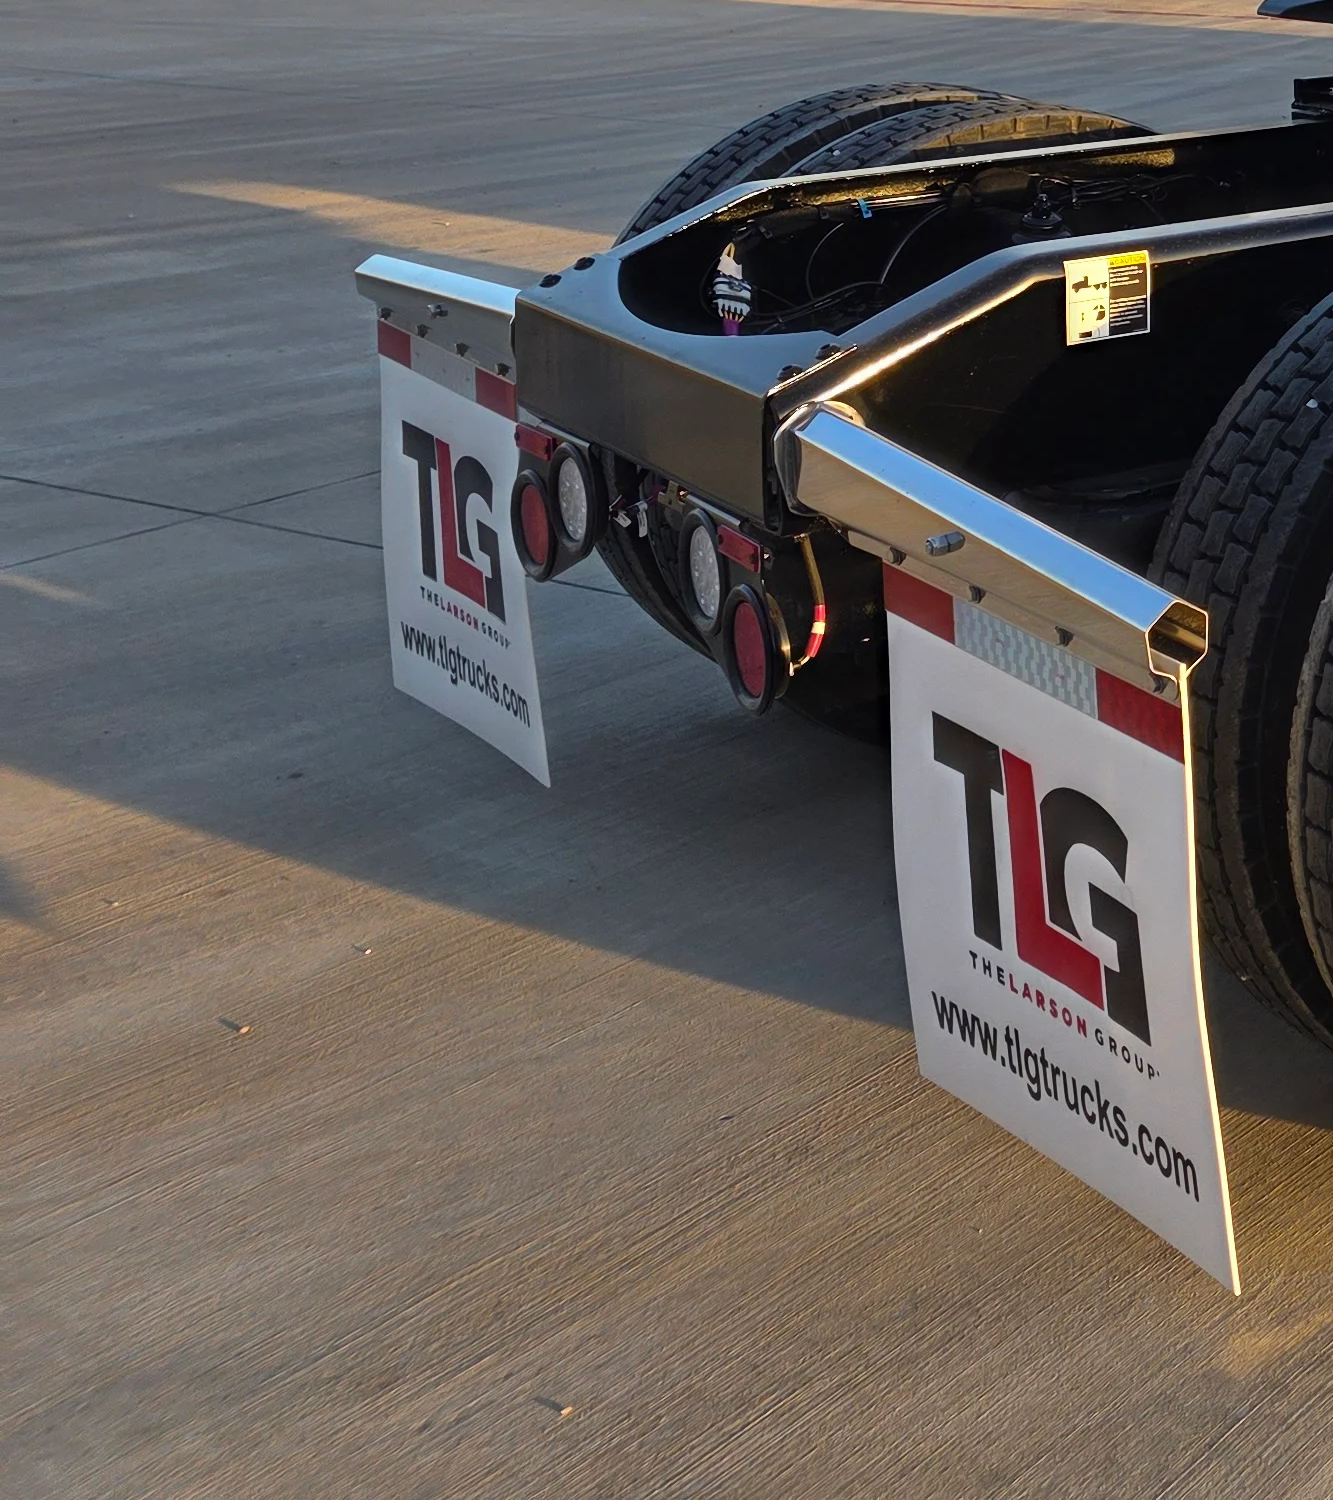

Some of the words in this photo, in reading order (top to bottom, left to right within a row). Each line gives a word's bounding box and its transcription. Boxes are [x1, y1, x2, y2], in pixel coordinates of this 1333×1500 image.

[1114, 256, 1146, 265] CAUTION
[402, 420, 506, 626] TLG
[401, 621, 531, 729] www.tlgtrucks.com
[481, 621, 510, 650] GROUP
[932, 710, 1152, 1047] TLG
[931, 990, 1200, 1203] www.tlgtrucks.com
[1095, 1027, 1157, 1078] GROUP
